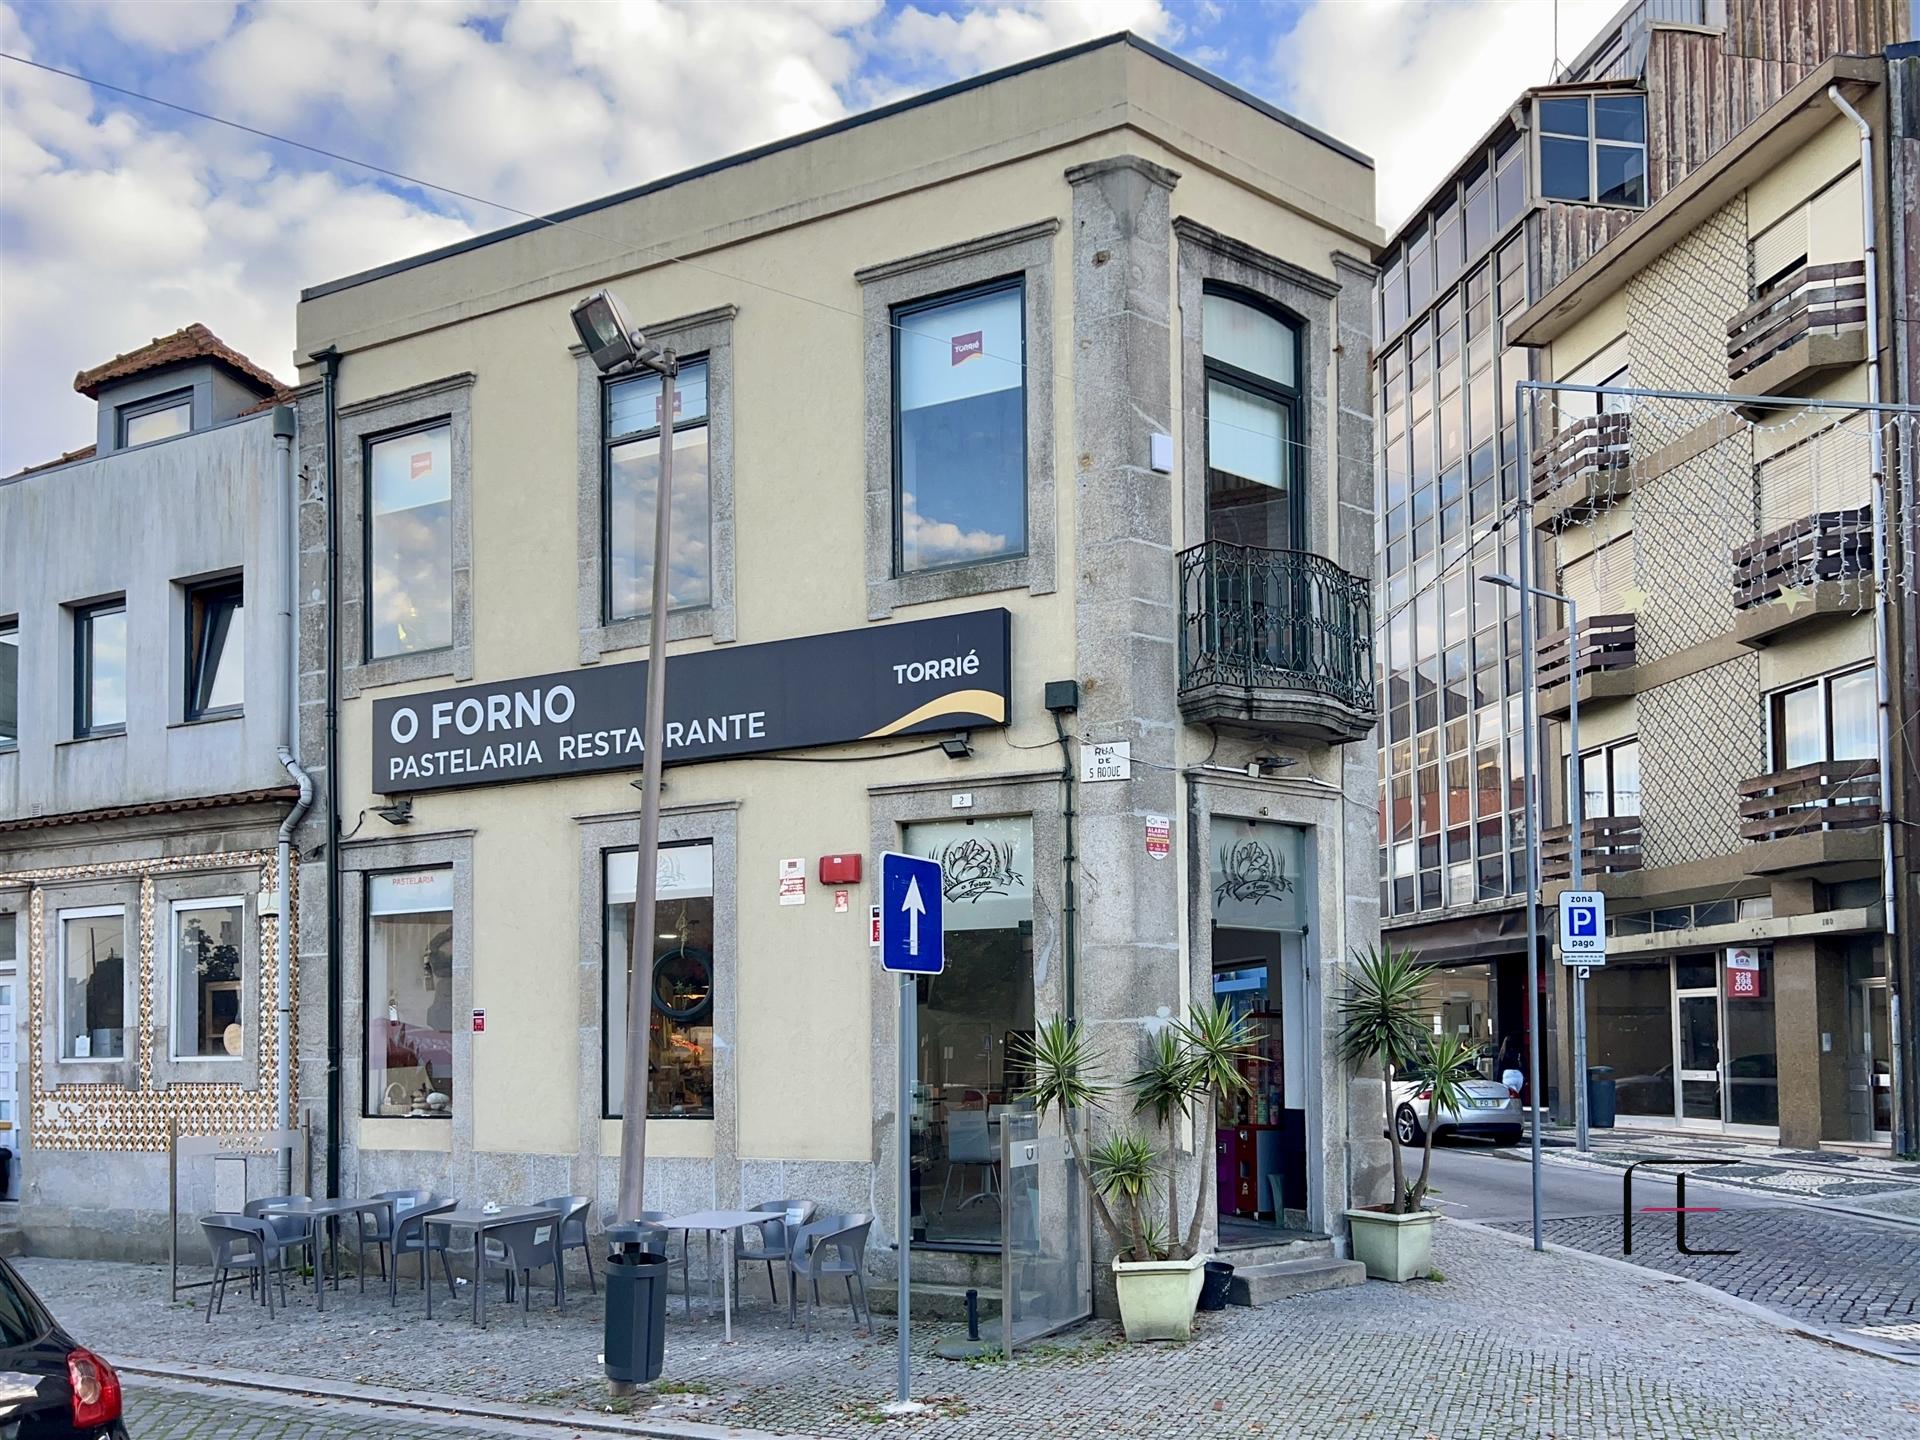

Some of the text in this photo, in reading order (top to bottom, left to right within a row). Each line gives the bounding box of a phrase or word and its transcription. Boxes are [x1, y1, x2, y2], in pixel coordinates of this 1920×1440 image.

[391, 685, 576, 744] O FORNO
[390, 711, 766, 781] PASTELARIA RESTARANTE
[1094, 747, 1114, 756] RUA
[392, 876, 434, 886] PASTELARIA
[1571, 895, 1593, 903] zona
[1573, 908, 1591, 935] P
[1572, 940, 1594, 949] pago
[1735, 971, 1751, 979] 229
